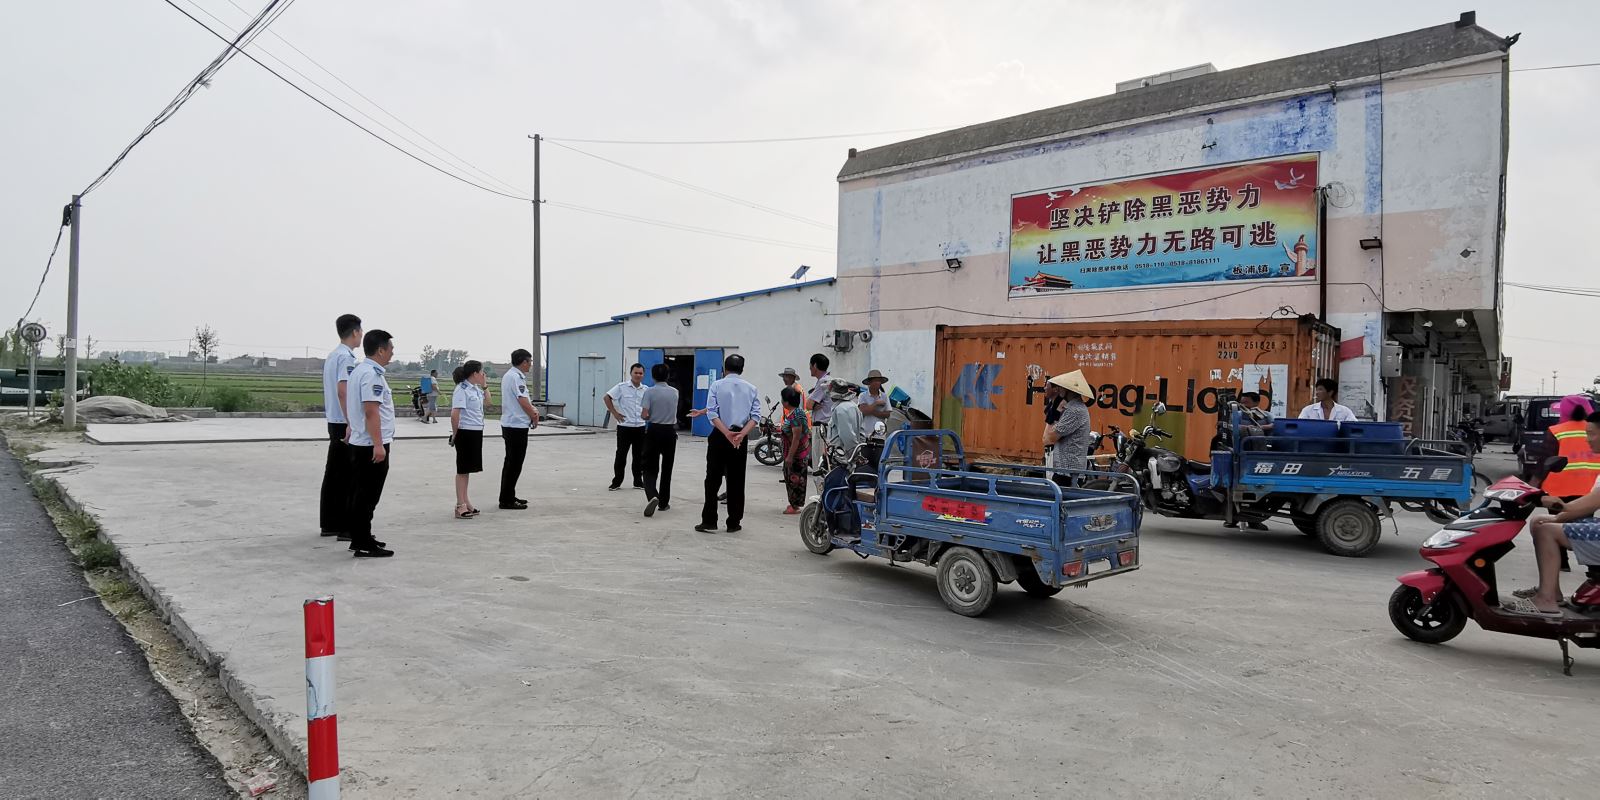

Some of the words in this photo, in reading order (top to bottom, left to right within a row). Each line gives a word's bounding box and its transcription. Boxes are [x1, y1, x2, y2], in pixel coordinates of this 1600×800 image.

[1050, 183, 1262, 230] 坚决铲除黑恶势力
[1037, 222, 1277, 265] 让黑恶势力无路可逃
[1217, 341, 1238, 349] HLXU
[1254, 462, 1303, 475] 福田
[1399, 467, 1453, 480] 五星
